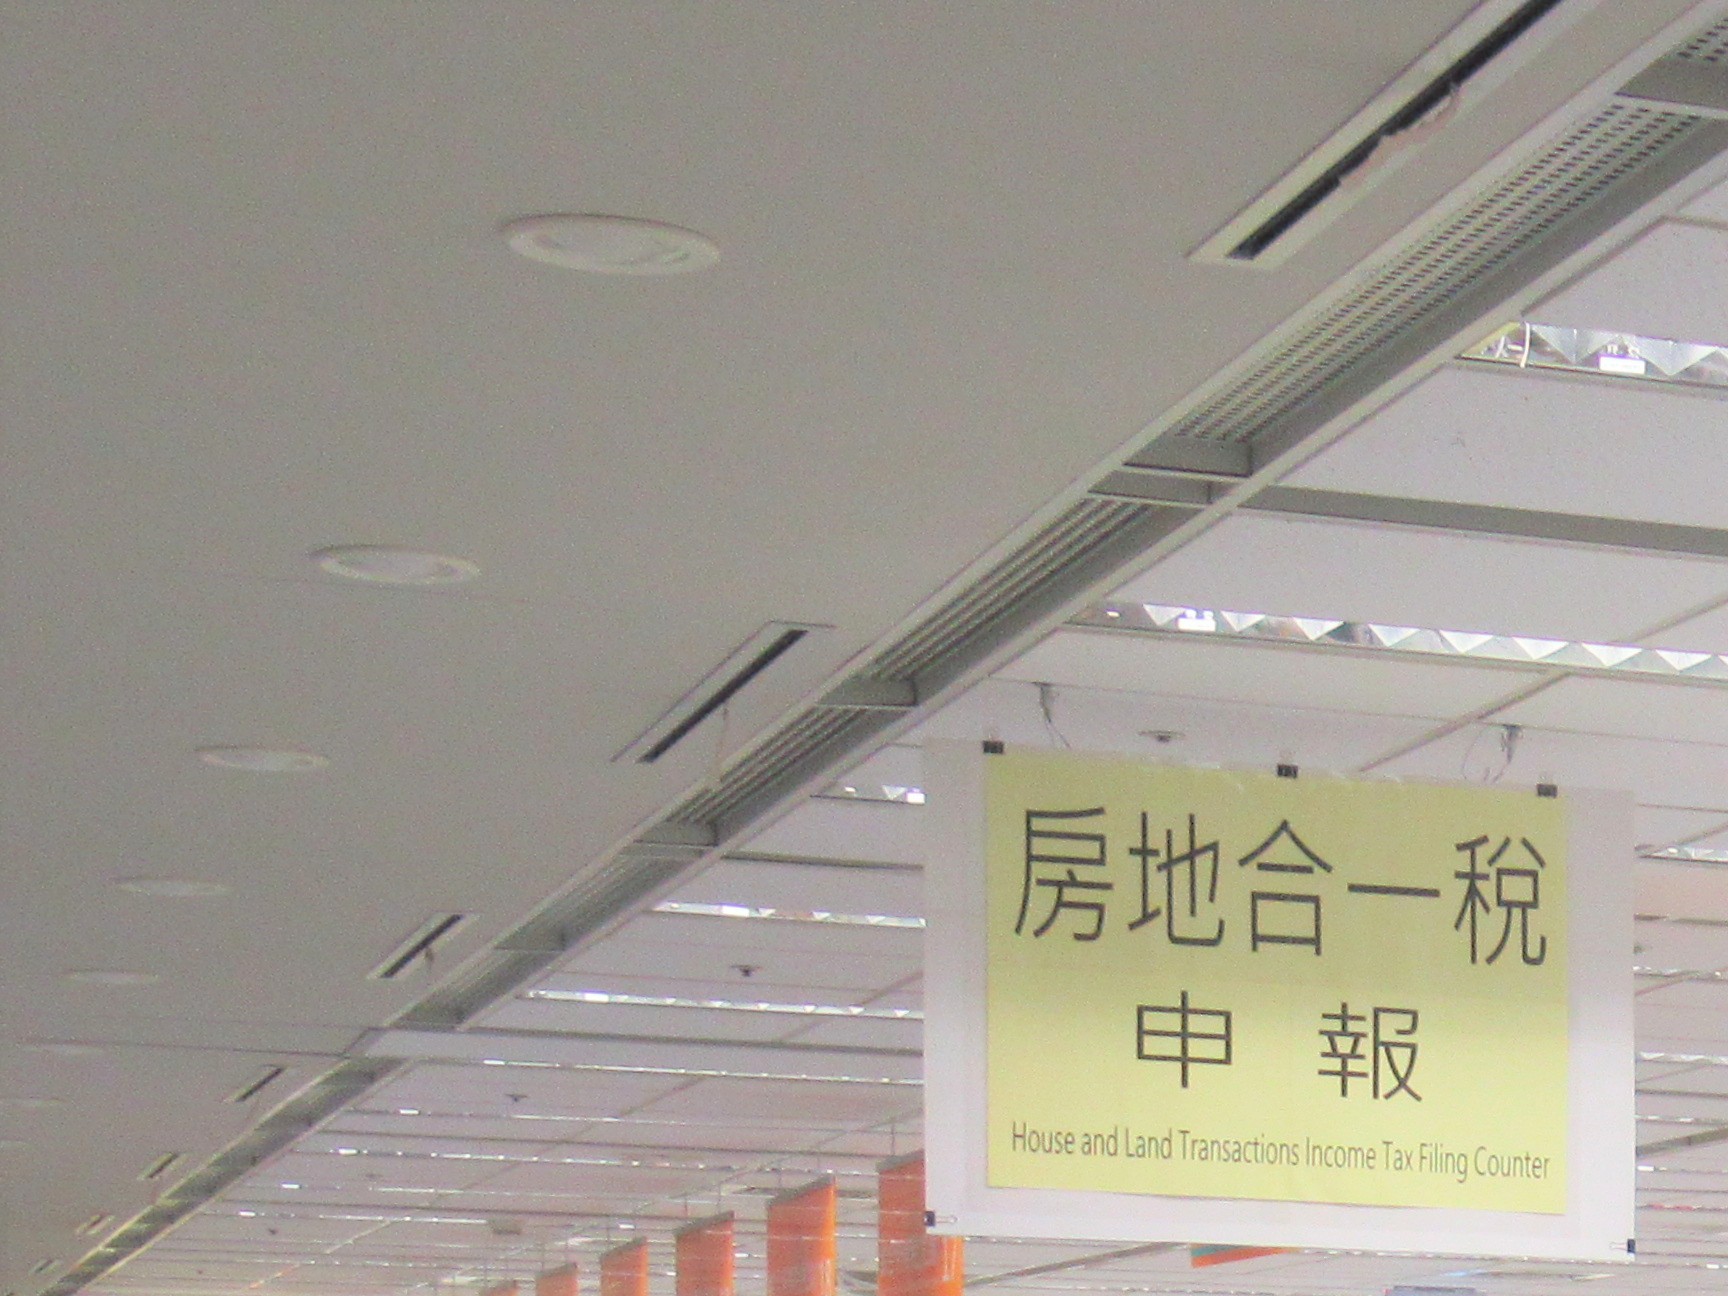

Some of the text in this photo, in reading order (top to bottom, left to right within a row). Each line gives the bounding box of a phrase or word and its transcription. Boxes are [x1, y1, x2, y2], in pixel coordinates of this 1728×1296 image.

[1014, 807, 1547, 966] 房地合一稅
[1012, 1121, 1550, 1183] House and Land Transactions Income Tax Filing Counter
